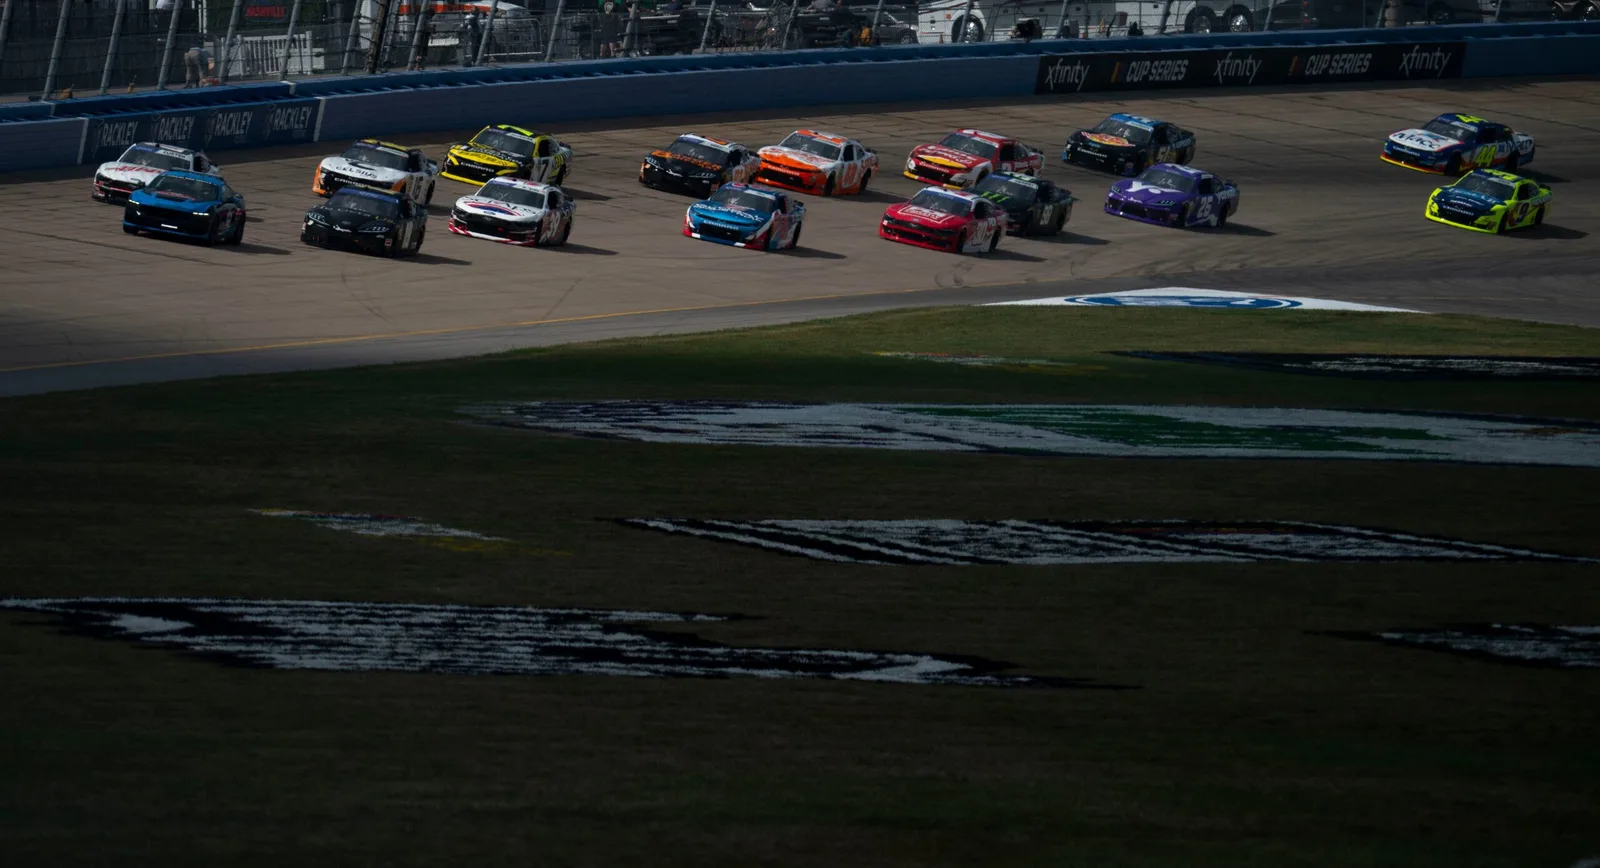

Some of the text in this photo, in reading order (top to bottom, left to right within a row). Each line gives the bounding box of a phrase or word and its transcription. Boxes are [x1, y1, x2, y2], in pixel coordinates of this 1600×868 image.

[1126, 59, 1190, 83] CUP SERIES
[1214, 52, 1263, 85] xfinity
[1305, 53, 1373, 77] CUP SERIES
[1399, 45, 1452, 78] xfinity
[1045, 58, 1091, 92] xfinity
[157, 116, 196, 141] RACKLEY
[215, 111, 254, 137] RACKLEY
[273, 106, 313, 131] RACKLEY
[102, 120, 139, 147] RACKLEY
[1475, 145, 1497, 167] 44
[336, 165, 378, 180] CELSIUS
